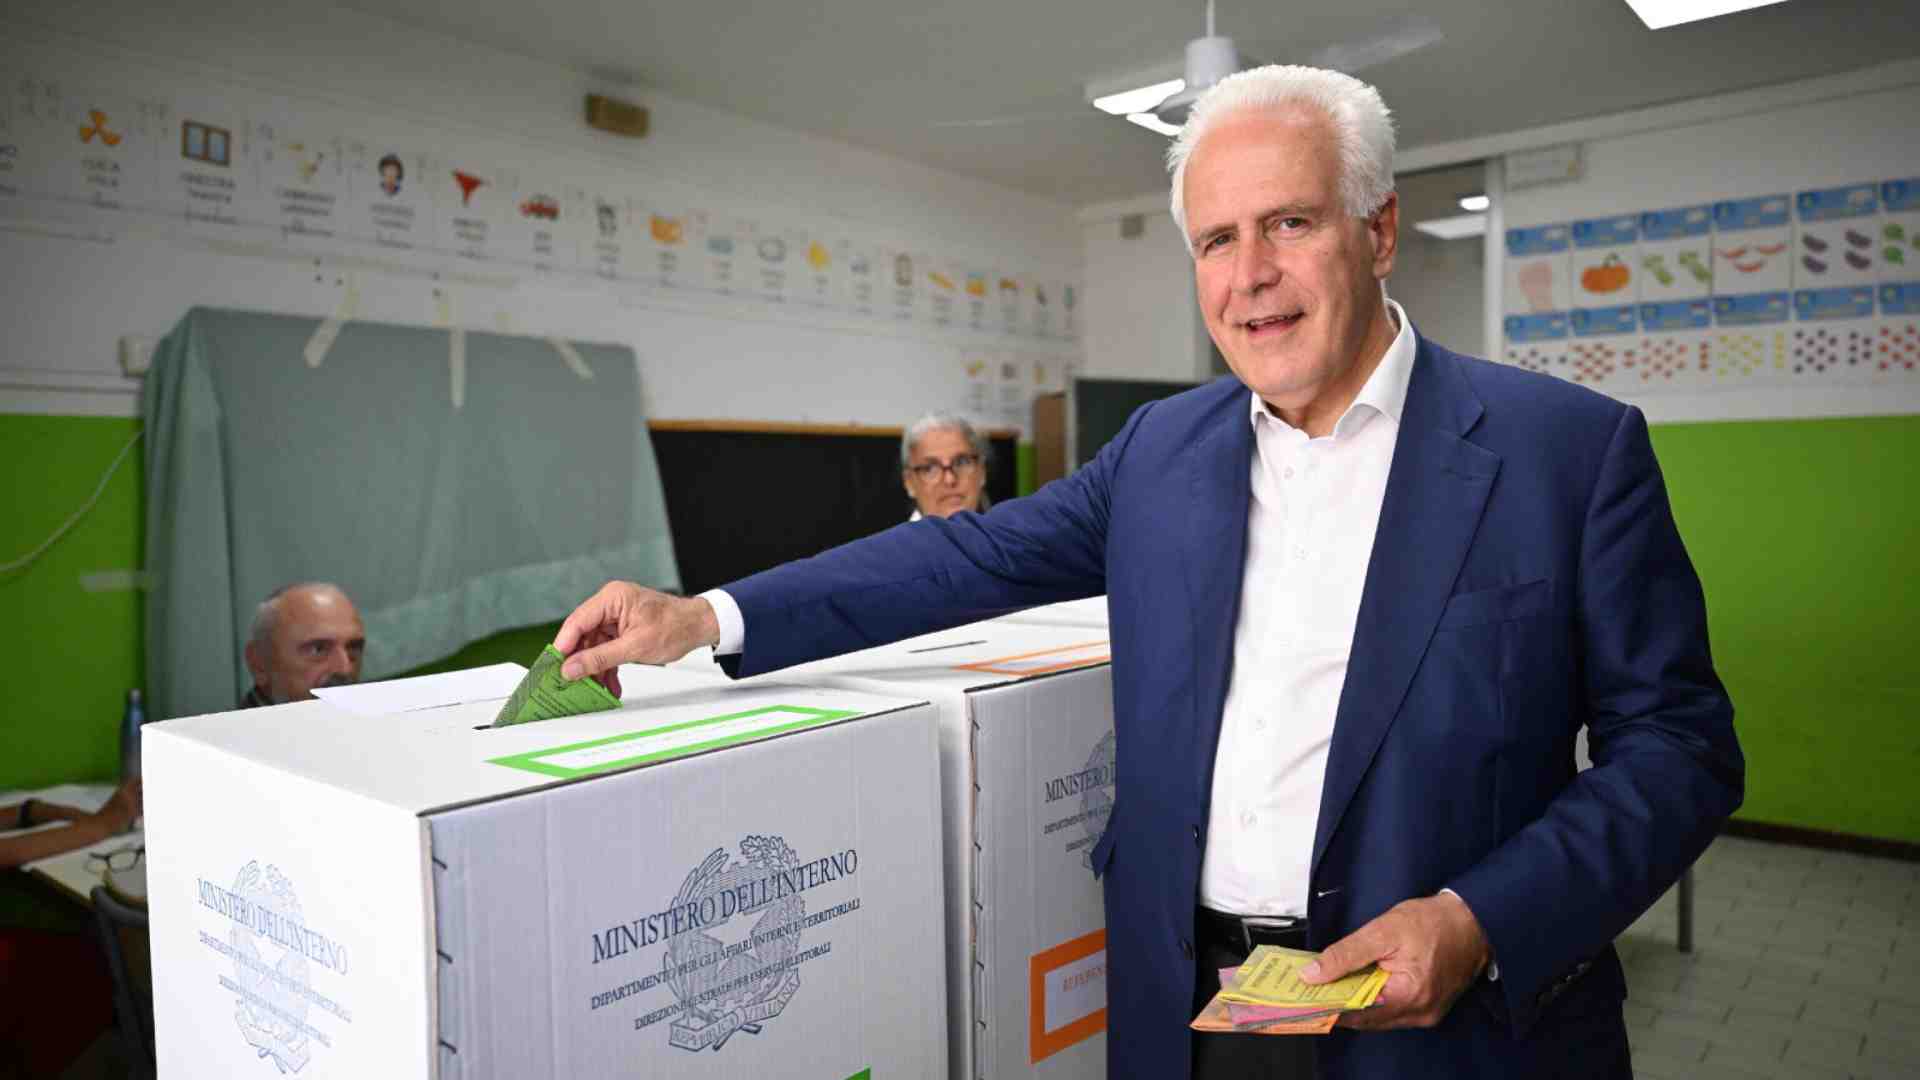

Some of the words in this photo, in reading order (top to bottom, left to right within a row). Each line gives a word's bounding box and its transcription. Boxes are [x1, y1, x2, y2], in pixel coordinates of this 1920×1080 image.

[1044, 767, 1109, 803] MINISTERO
[197, 877, 256, 929] MINISTERO
[592, 896, 715, 965] MINISTERO
[720, 849, 858, 919] DELL'INTERNO
[591, 968, 677, 1010] DIPARTIMENTO
